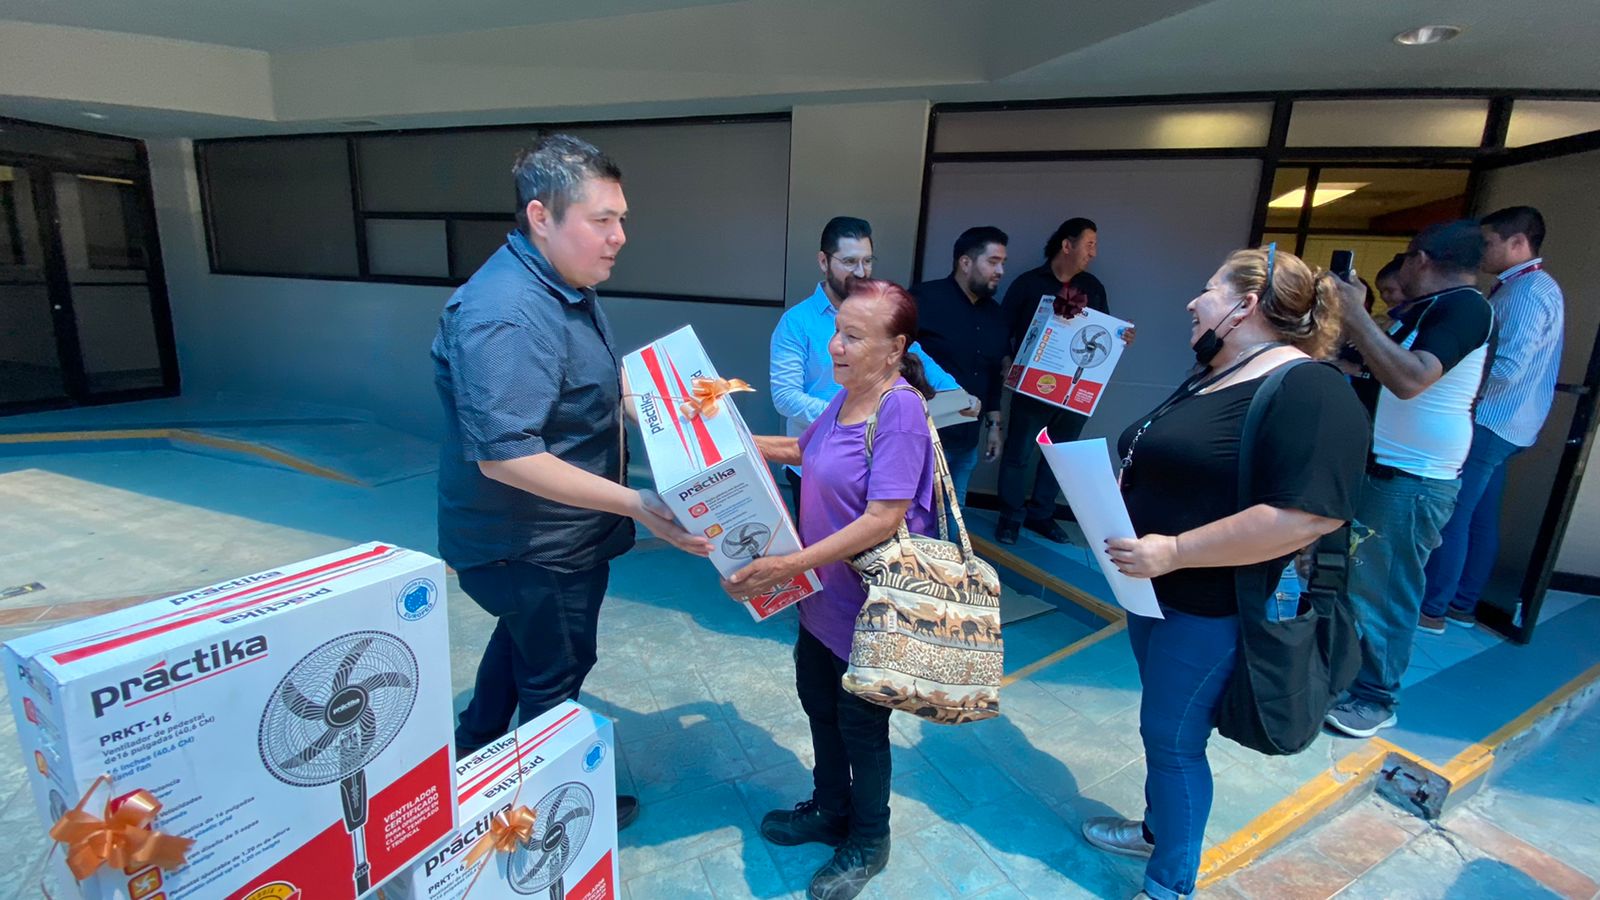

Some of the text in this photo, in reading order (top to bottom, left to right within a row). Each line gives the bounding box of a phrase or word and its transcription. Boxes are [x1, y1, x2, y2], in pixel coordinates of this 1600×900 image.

[90, 634, 269, 719] práctika
[100, 711, 173, 747] PRKT-16
[102, 712, 206, 758] Ventilador de pedestal
[131, 733, 174, 756] pulgadas
[120, 754, 152, 771] inches
[383, 784, 437, 824] VENTILADOR
[384, 792, 439, 833] CERTIFICADO
[385, 825, 402, 840] PARA
[385, 829, 406, 846] CLIMA
